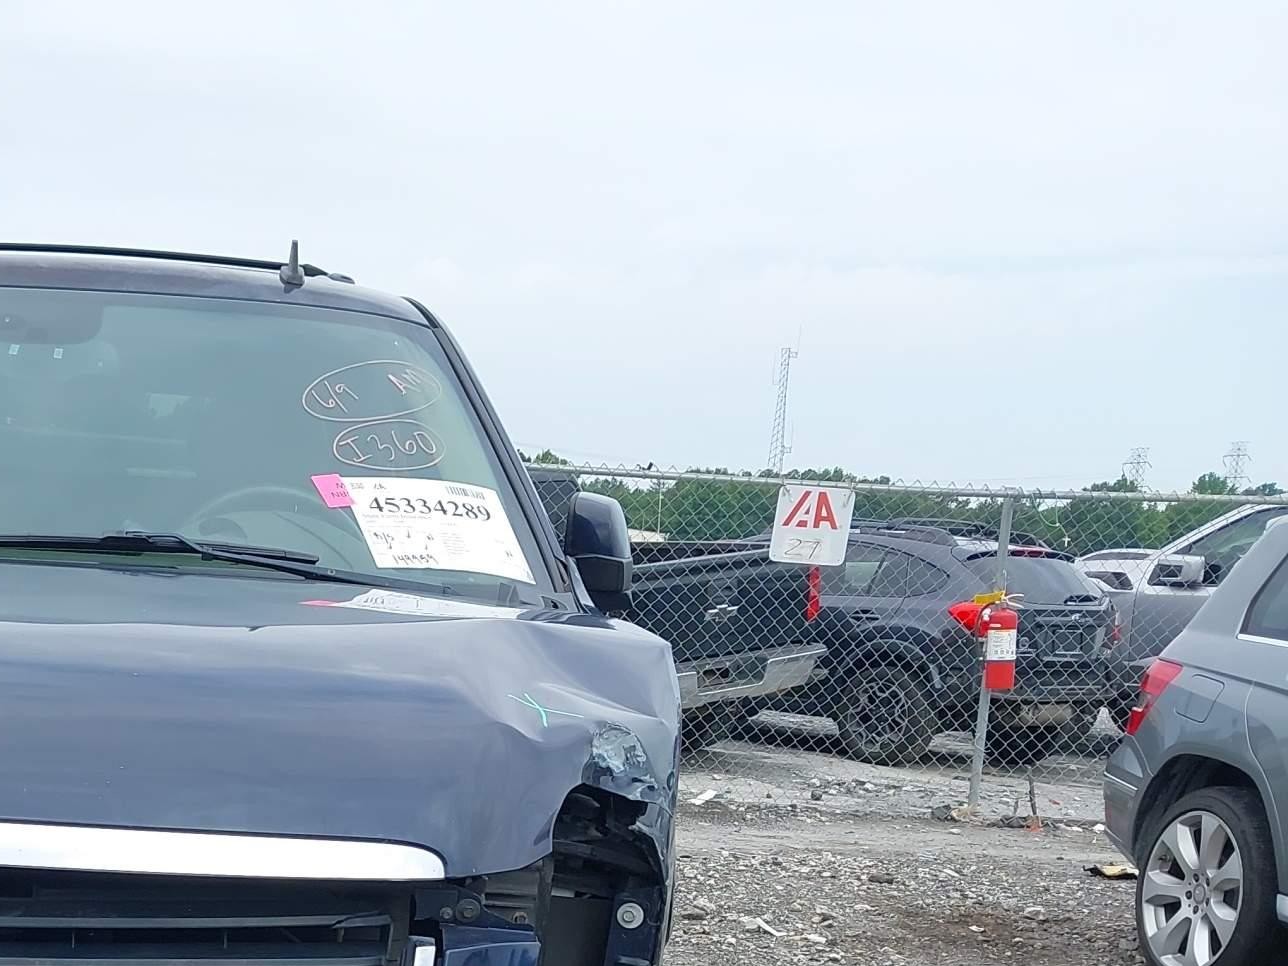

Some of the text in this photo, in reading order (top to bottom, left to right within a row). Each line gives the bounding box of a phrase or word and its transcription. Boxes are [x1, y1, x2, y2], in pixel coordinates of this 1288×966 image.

[311, 380, 359, 413] 6/9
[368, 496, 491, 521] 45334289
[784, 538, 821, 560] 27
